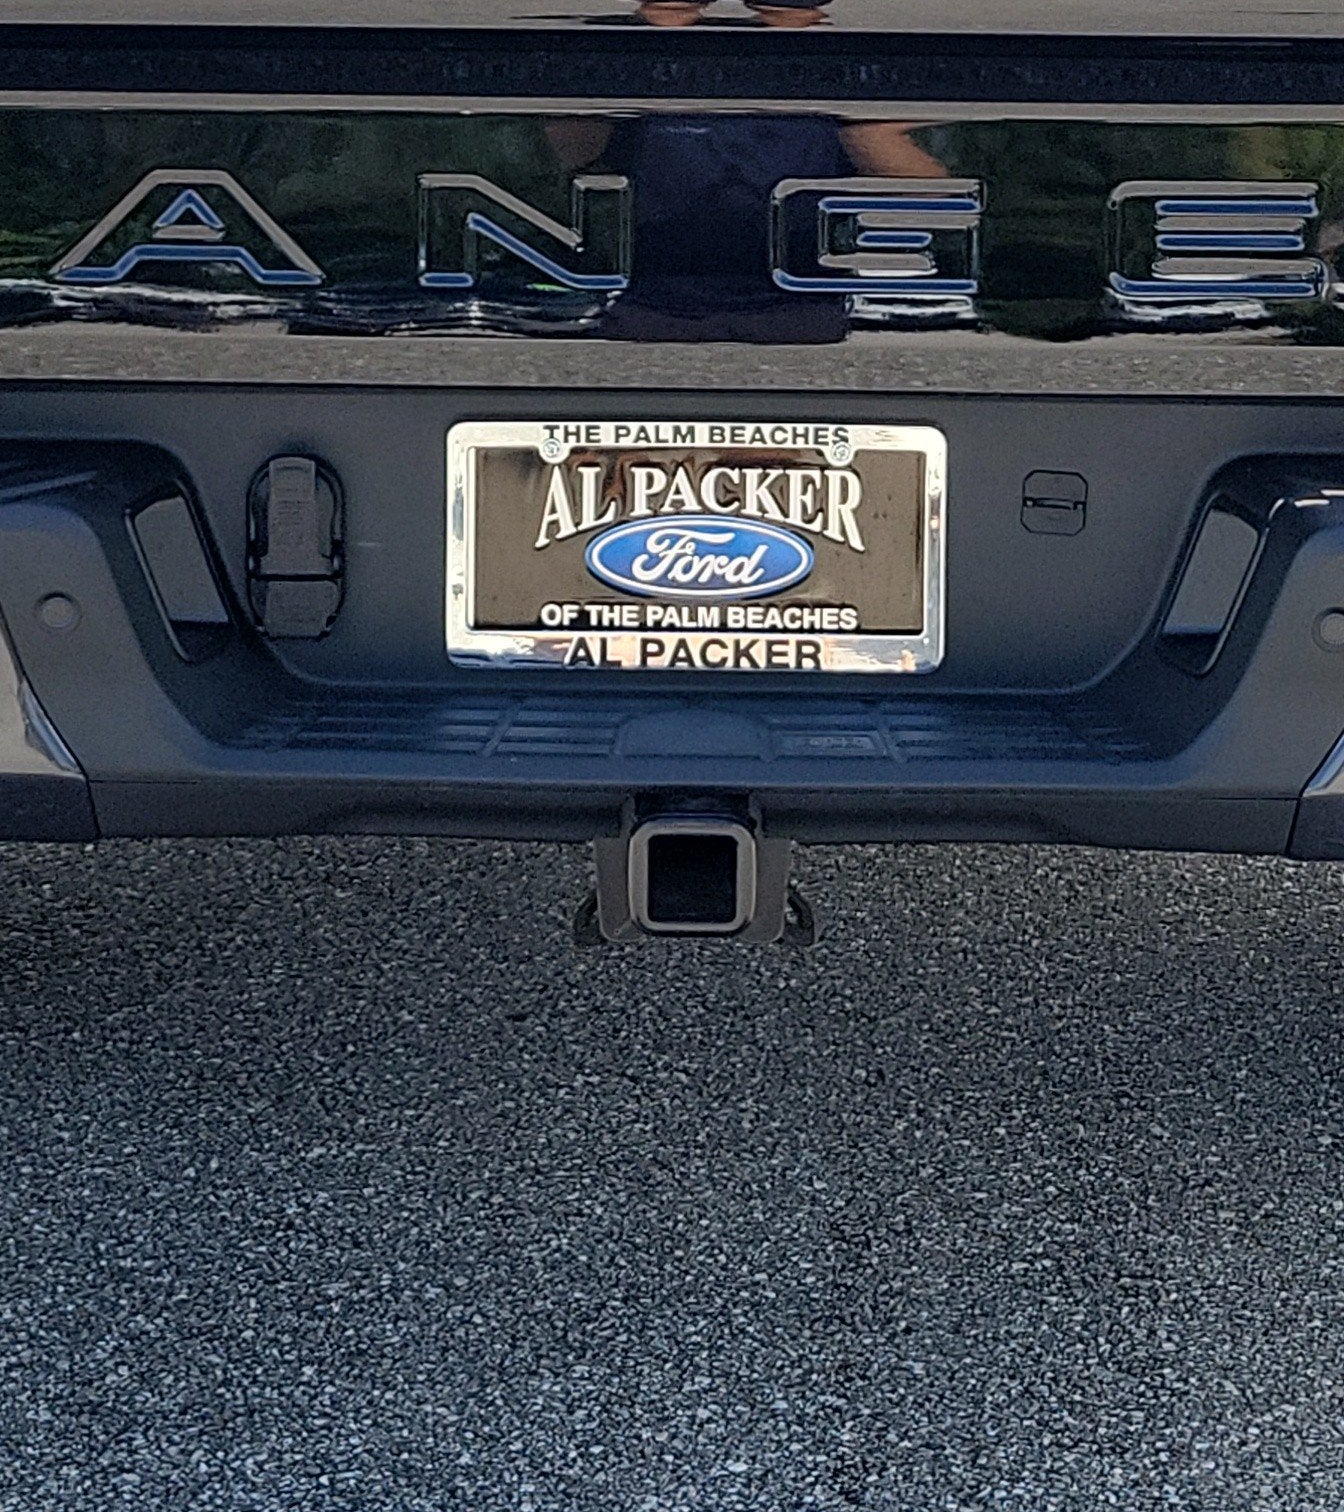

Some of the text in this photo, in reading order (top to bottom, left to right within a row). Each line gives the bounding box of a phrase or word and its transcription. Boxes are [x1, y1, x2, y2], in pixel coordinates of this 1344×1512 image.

[543, 425, 850, 447] THE PALM BEACHES
[534, 465, 866, 553] AL PACKER
[631, 528, 769, 585] Ford
[541, 605, 858, 631] OF THE PALM BEACHES
[565, 638, 823, 670] AL PACKER
